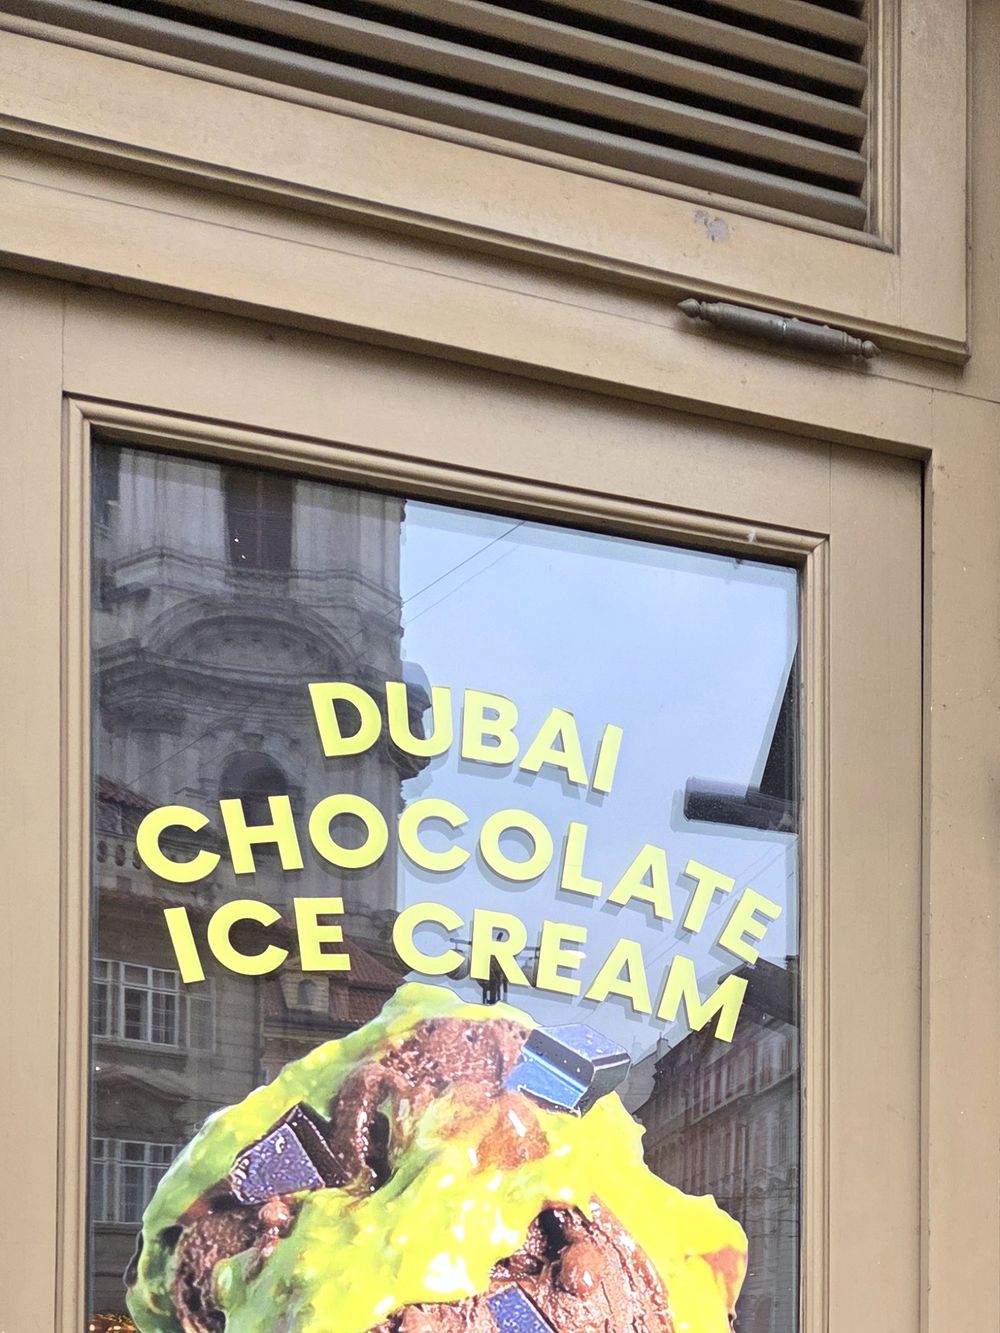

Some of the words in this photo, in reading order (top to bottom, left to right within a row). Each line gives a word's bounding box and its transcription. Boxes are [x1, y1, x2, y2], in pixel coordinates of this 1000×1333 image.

[307, 681, 624, 793] DUBAI
[136, 793, 782, 966] CHOCOLATE
[164, 897, 352, 984] ICE
[392, 902, 749, 1043] CREAM
